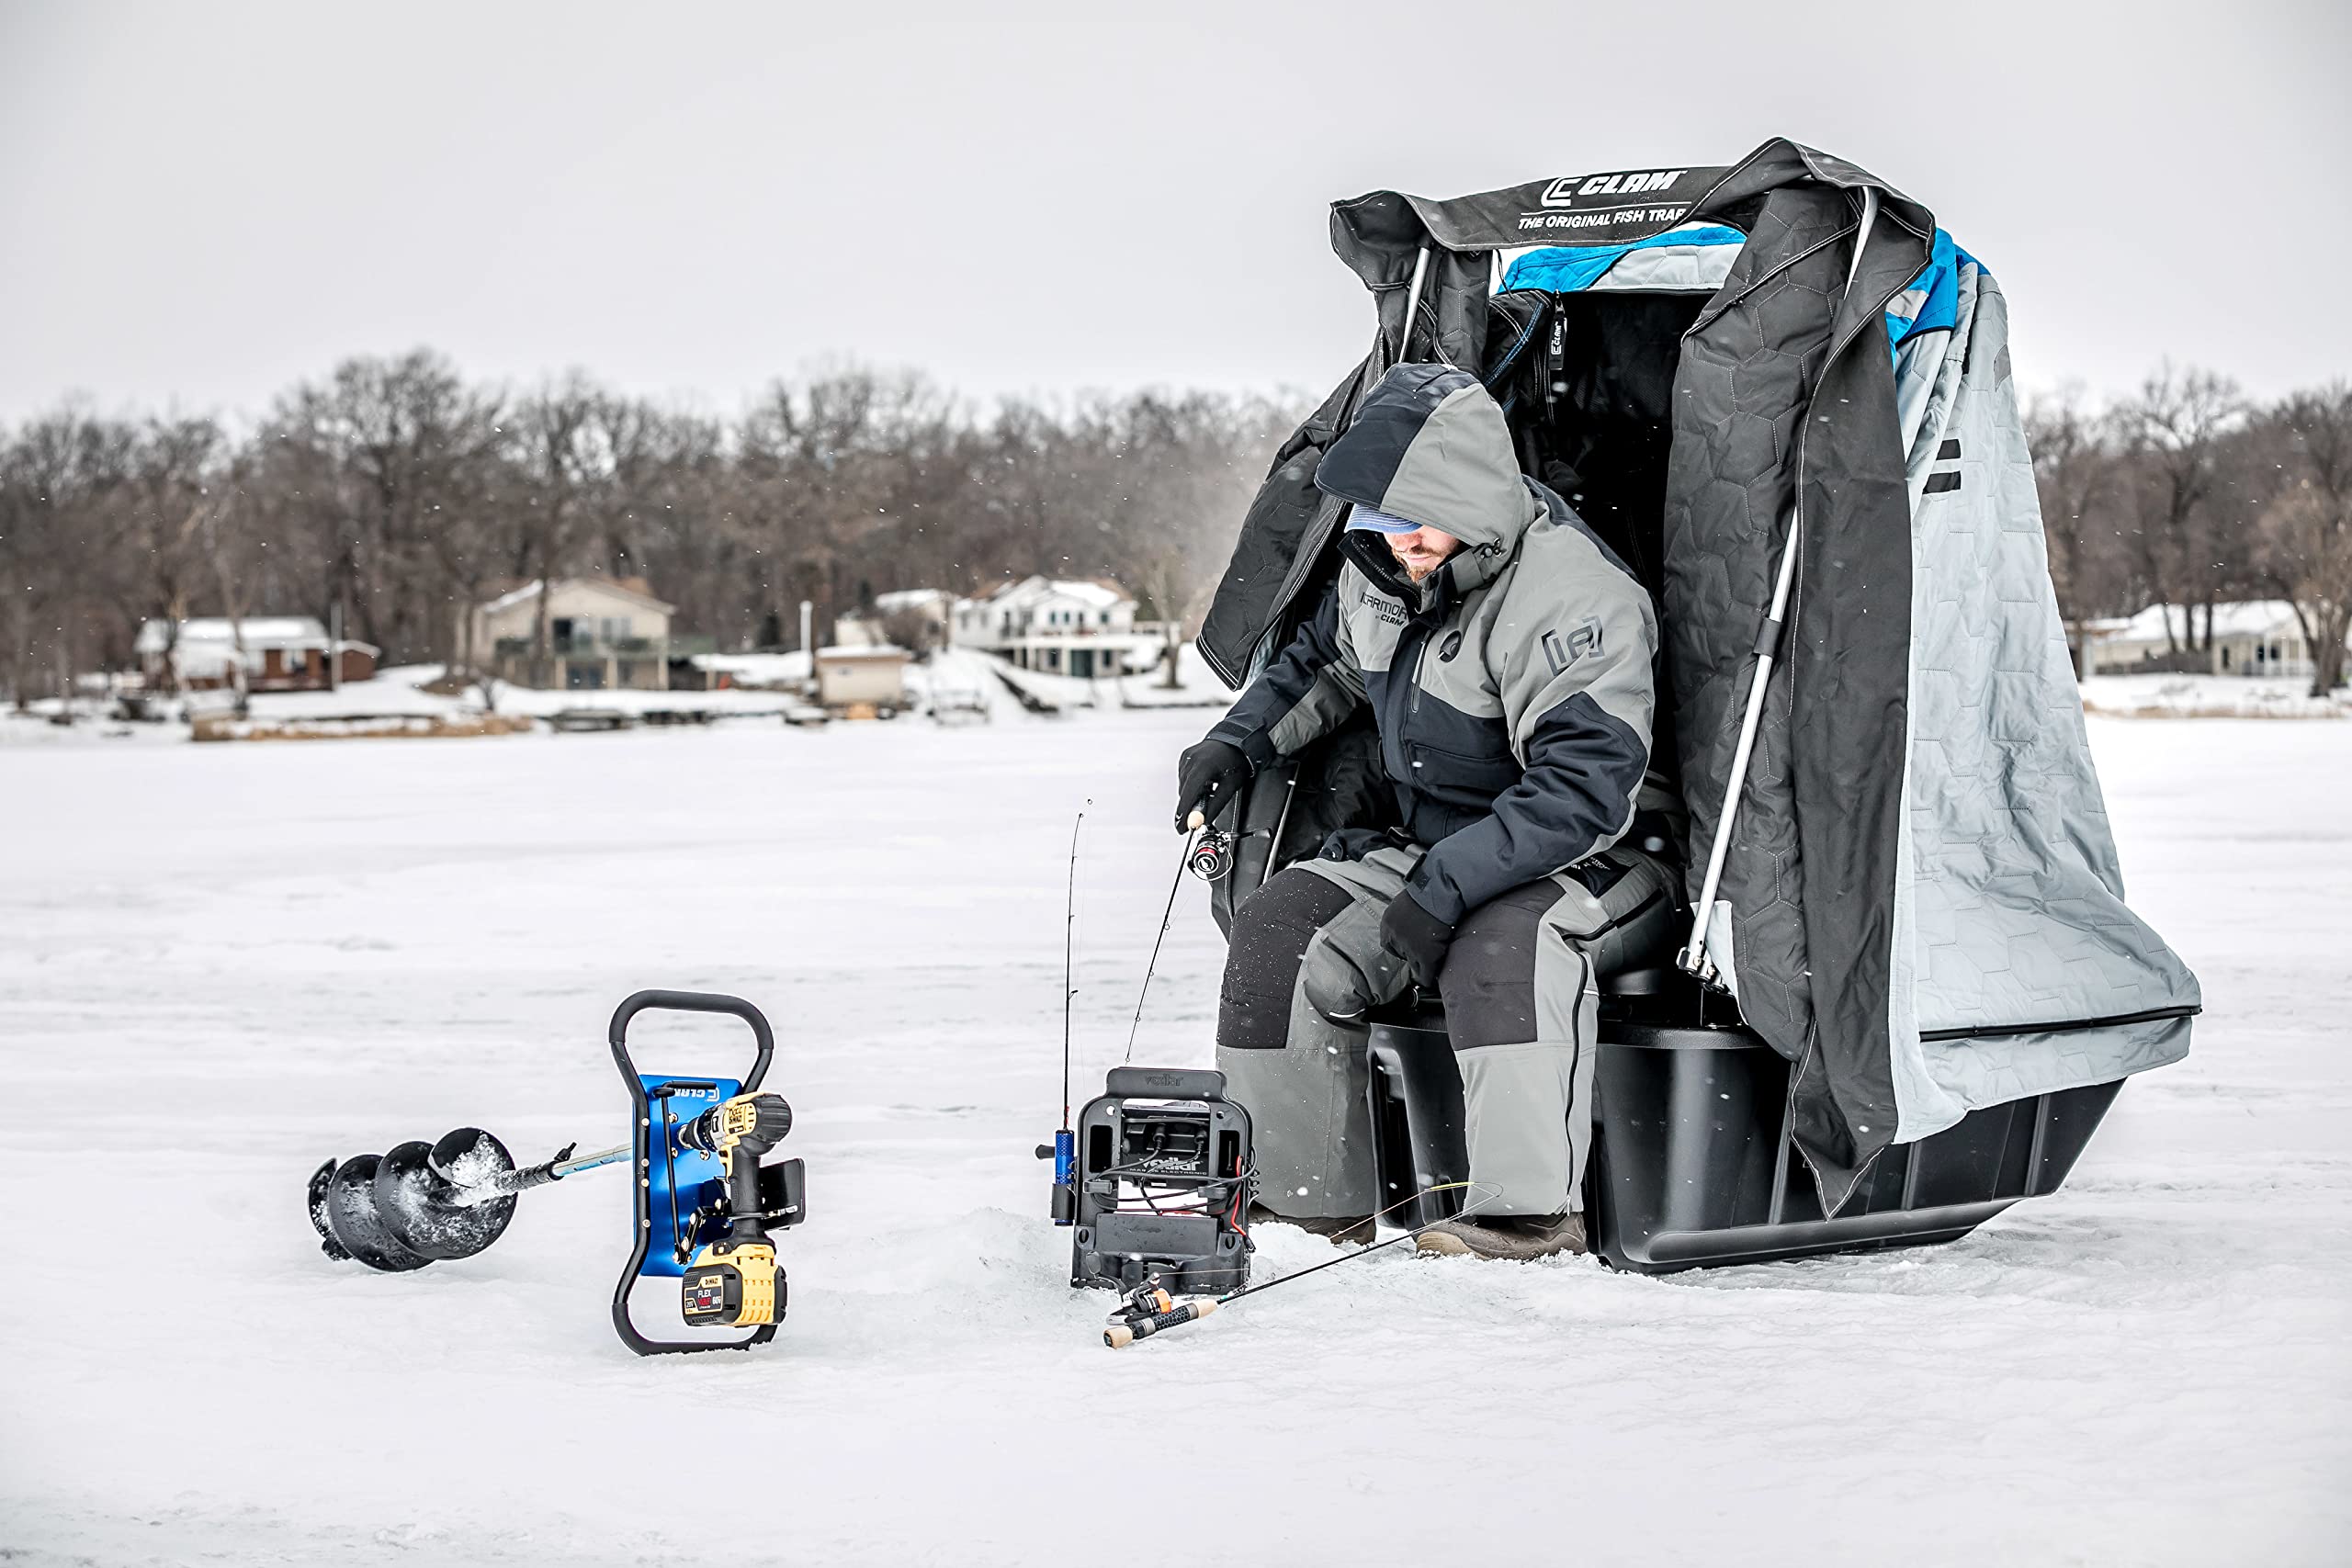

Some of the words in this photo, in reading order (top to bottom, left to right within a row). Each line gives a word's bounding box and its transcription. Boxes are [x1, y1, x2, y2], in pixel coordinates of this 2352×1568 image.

[1577, 170, 1681, 196] CLAM
[1518, 217, 1544, 230] THE
[1545, 213, 1611, 228] ORIGINAL
[1612, 209, 1645, 224] FISH
[1380, 614, 1405, 626] CLAM
[697, 1289, 712, 1298] FLEX
